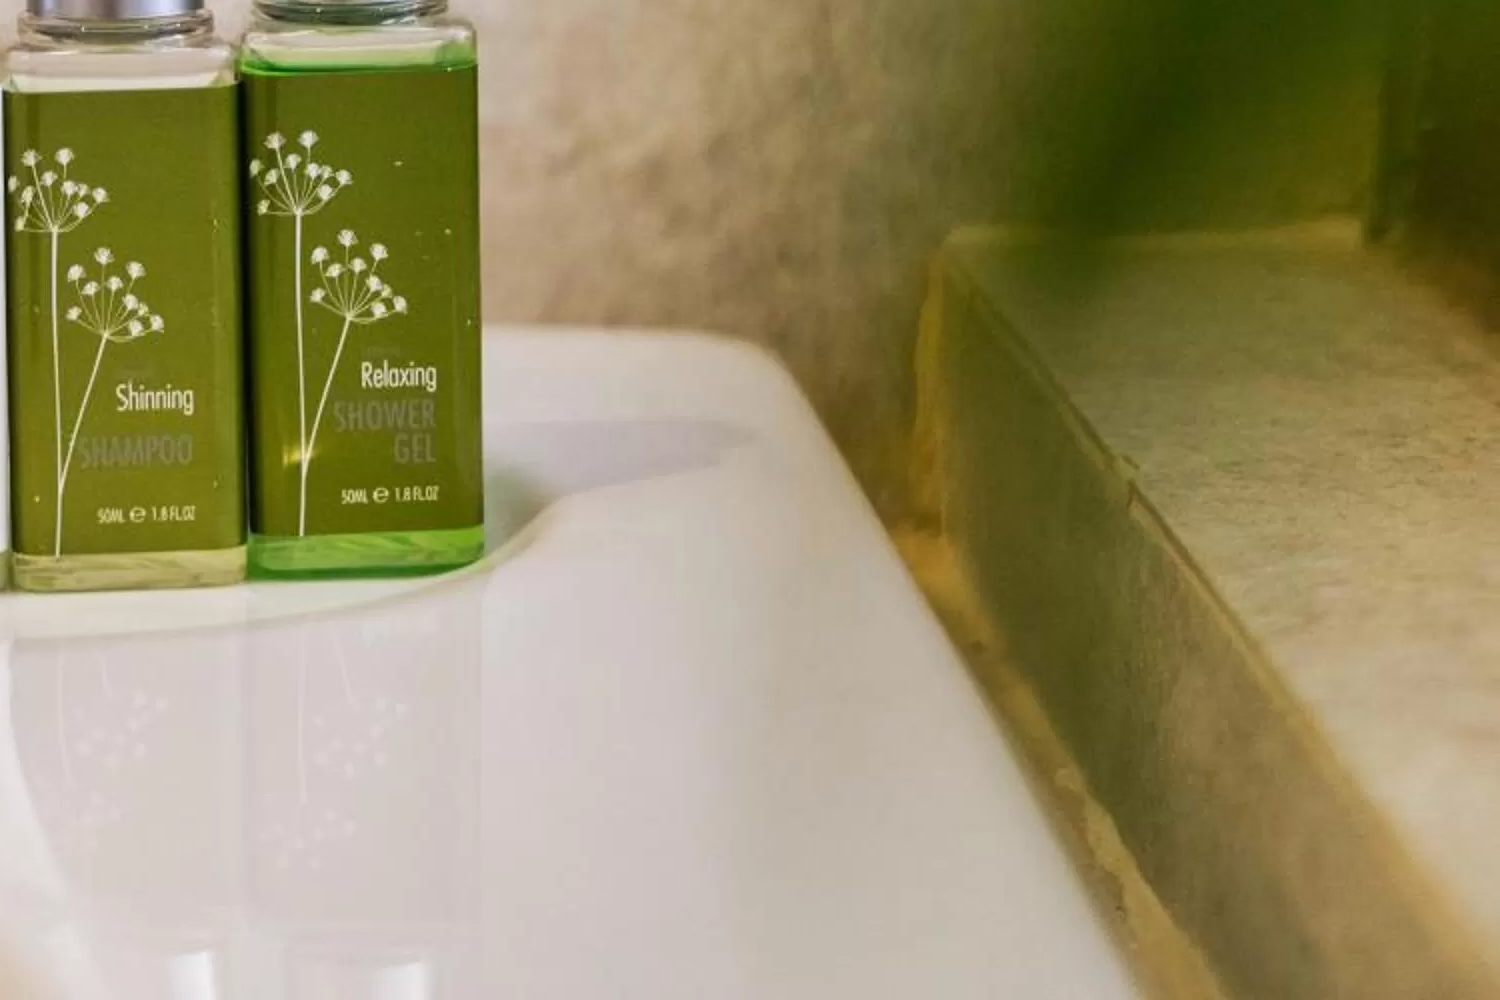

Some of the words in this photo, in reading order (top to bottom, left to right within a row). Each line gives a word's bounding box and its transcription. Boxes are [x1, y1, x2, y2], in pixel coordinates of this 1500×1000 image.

[361, 360, 437, 393] Relaxing
[115, 380, 196, 415] Shinning
[334, 400, 437, 431] SHOWER
[79, 434, 194, 468] SHAMPOO
[394, 433, 437, 463] GEL
[341, 488, 368, 504] 50ML
[97, 507, 125, 524] 50ML
